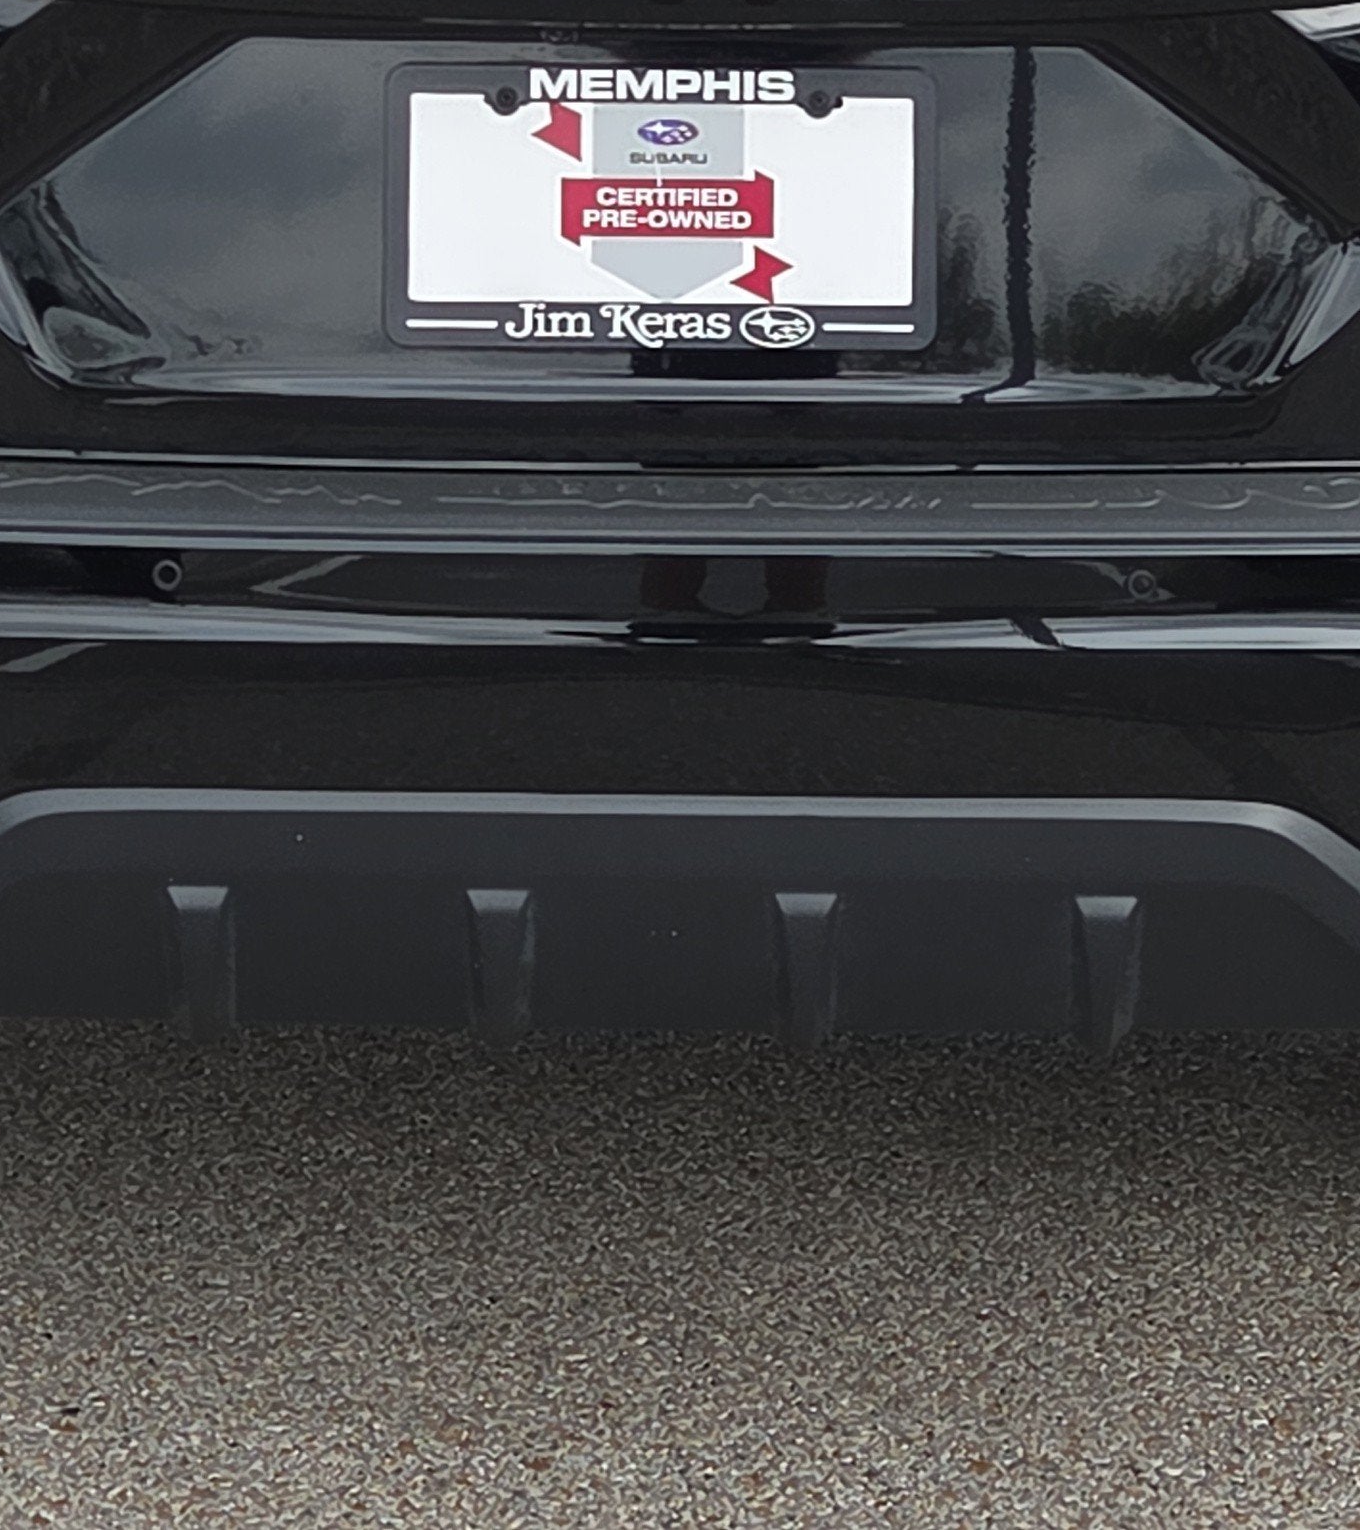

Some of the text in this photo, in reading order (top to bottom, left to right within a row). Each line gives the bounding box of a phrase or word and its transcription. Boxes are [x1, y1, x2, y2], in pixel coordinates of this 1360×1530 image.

[530, 68, 796, 102] MEMPHIS
[629, 151, 708, 165] SUBARU
[596, 187, 738, 207] CERTIFIED
[582, 209, 753, 230] PRE-OWNED
[504, 303, 733, 349] Jim Keras
